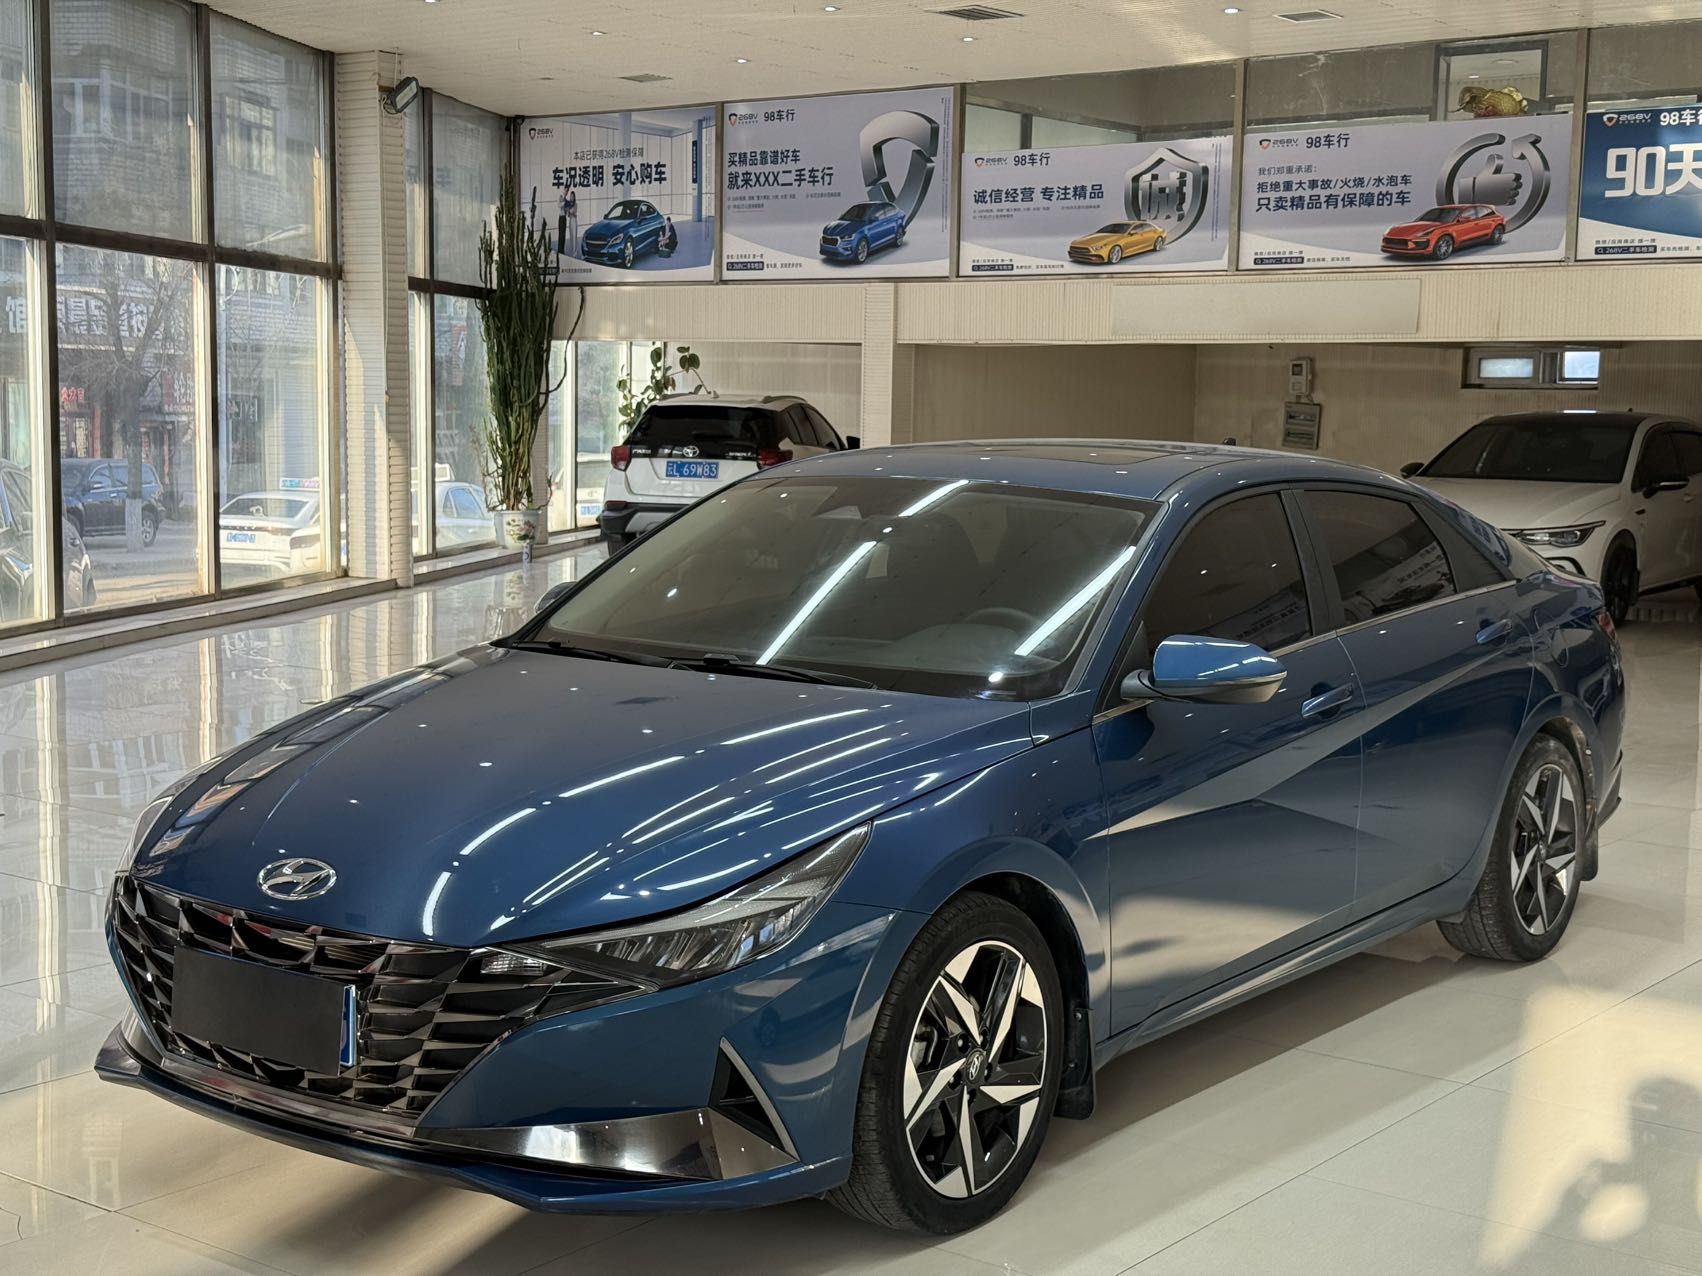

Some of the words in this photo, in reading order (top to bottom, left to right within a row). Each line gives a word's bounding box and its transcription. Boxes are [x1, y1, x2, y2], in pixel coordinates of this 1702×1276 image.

[763, 109, 796, 122] 98车行
[1619, 113, 1652, 121] 268V
[1305, 133, 1350, 149] 98车行
[727, 149, 801, 168] 买精品靠谱好车
[1013, 152, 1051, 167] 98车行
[552, 165, 604, 190] 车况透明
[612, 162, 667, 186] 安心购车
[726, 166, 834, 190] 就来XXX二手车行
[1604, 143, 1702, 198] 90天
[973, 187, 1036, 205] 诚信经营
[1040, 183, 1105, 201] 专注精品
[1256, 174, 1412, 194] 拒绝重大事故/火烧/水泡车
[1255, 190, 1412, 213] 只卖精品有保障的车
